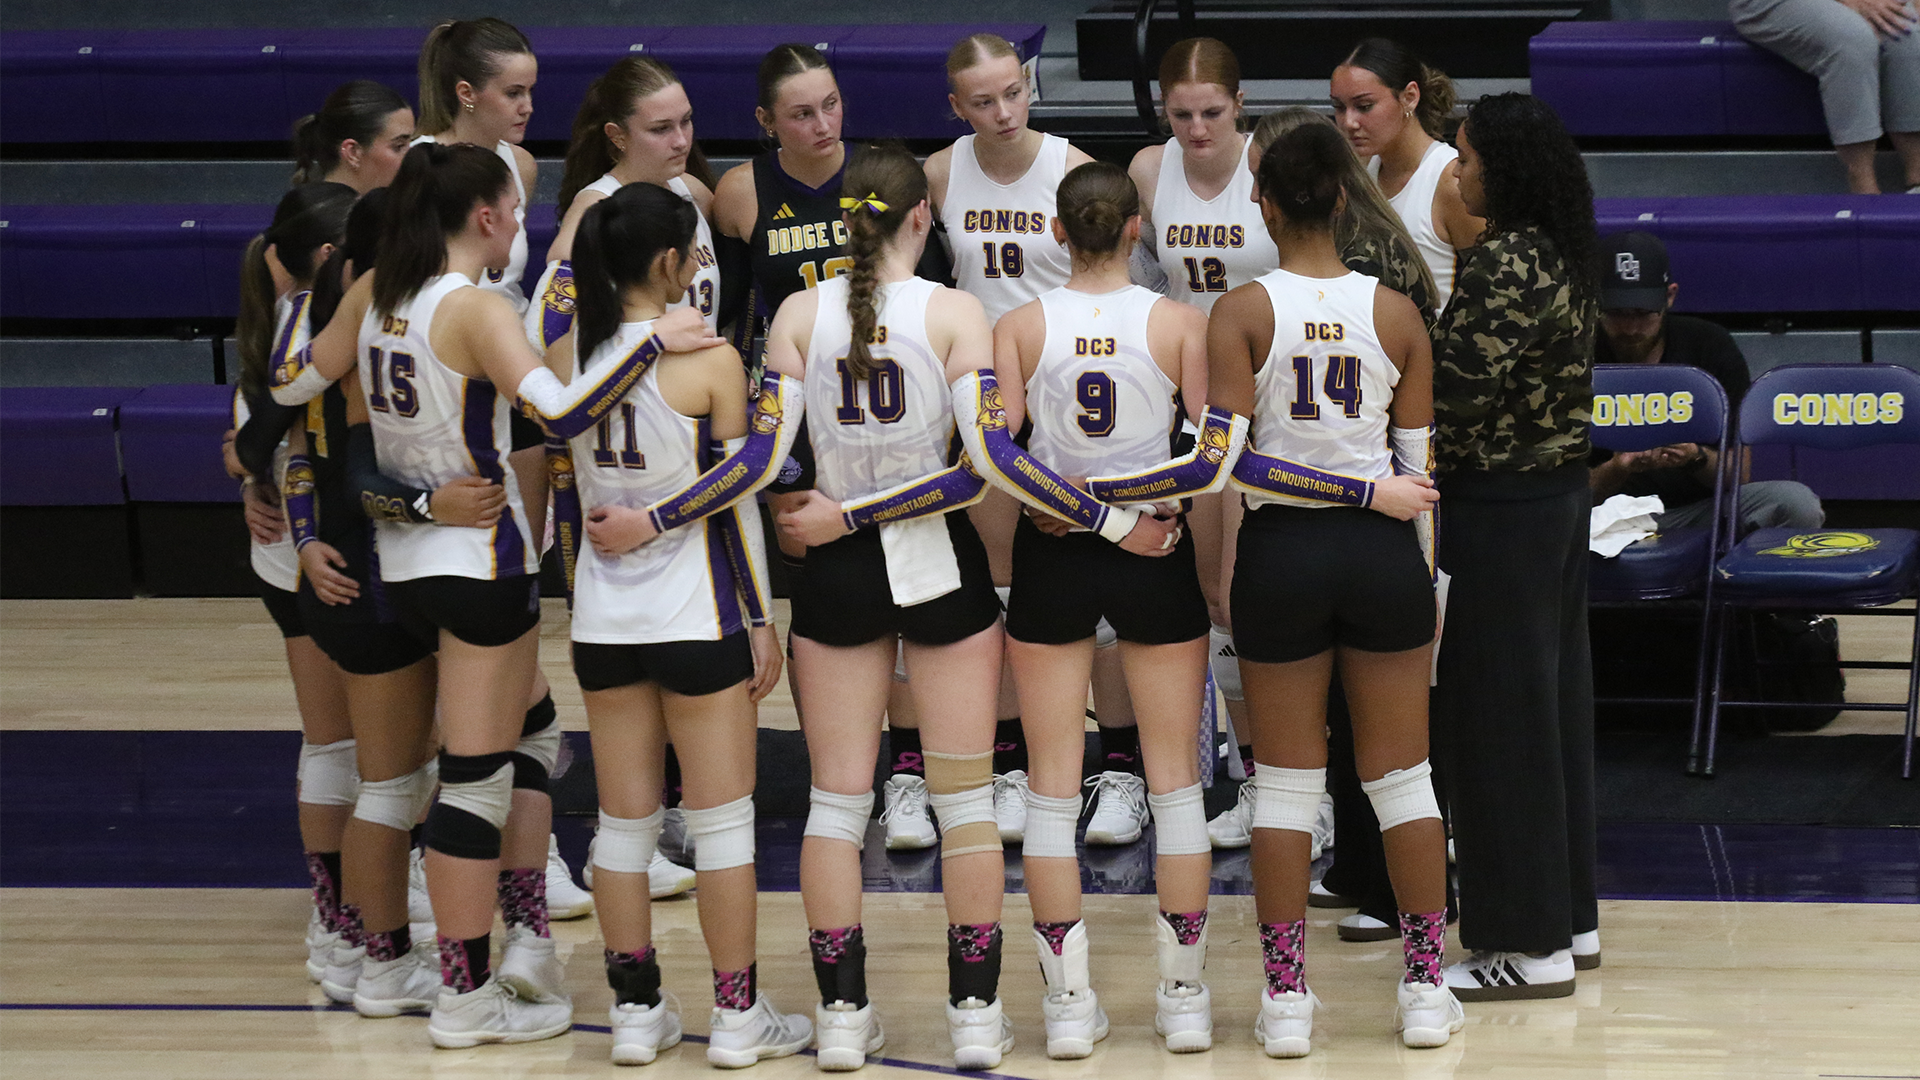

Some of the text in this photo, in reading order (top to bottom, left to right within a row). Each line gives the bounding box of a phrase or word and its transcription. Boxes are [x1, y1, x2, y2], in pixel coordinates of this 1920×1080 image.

[767, 222, 830, 256] DODGE
[964, 209, 1046, 234] CONQS
[1166, 224, 1245, 249] CONQS
[983, 242, 1024, 278] 18
[1183, 257, 1227, 292] 12
[688, 278, 714, 317] 13
[1075, 337, 1117, 357] DC3
[1304, 322, 1346, 342] DC3
[368, 346, 420, 418] 15
[587, 361, 646, 418] CONQUISTADORS
[836, 357, 907, 425] 10
[1290, 355, 1363, 420] 14
[1076, 371, 1117, 437] 9
[1592, 391, 1693, 426] ONQS
[1773, 392, 1904, 426] CONQS
[594, 402, 646, 470] 11
[679, 462, 748, 517] CONQUISTADORS
[1013, 455, 1080, 511] CONQUISTADORS
[1113, 477, 1177, 497] CONQUISTADORS
[1268, 467, 1344, 496] CONQUISTADORS
[873, 489, 944, 522] CONQUISTADORS
